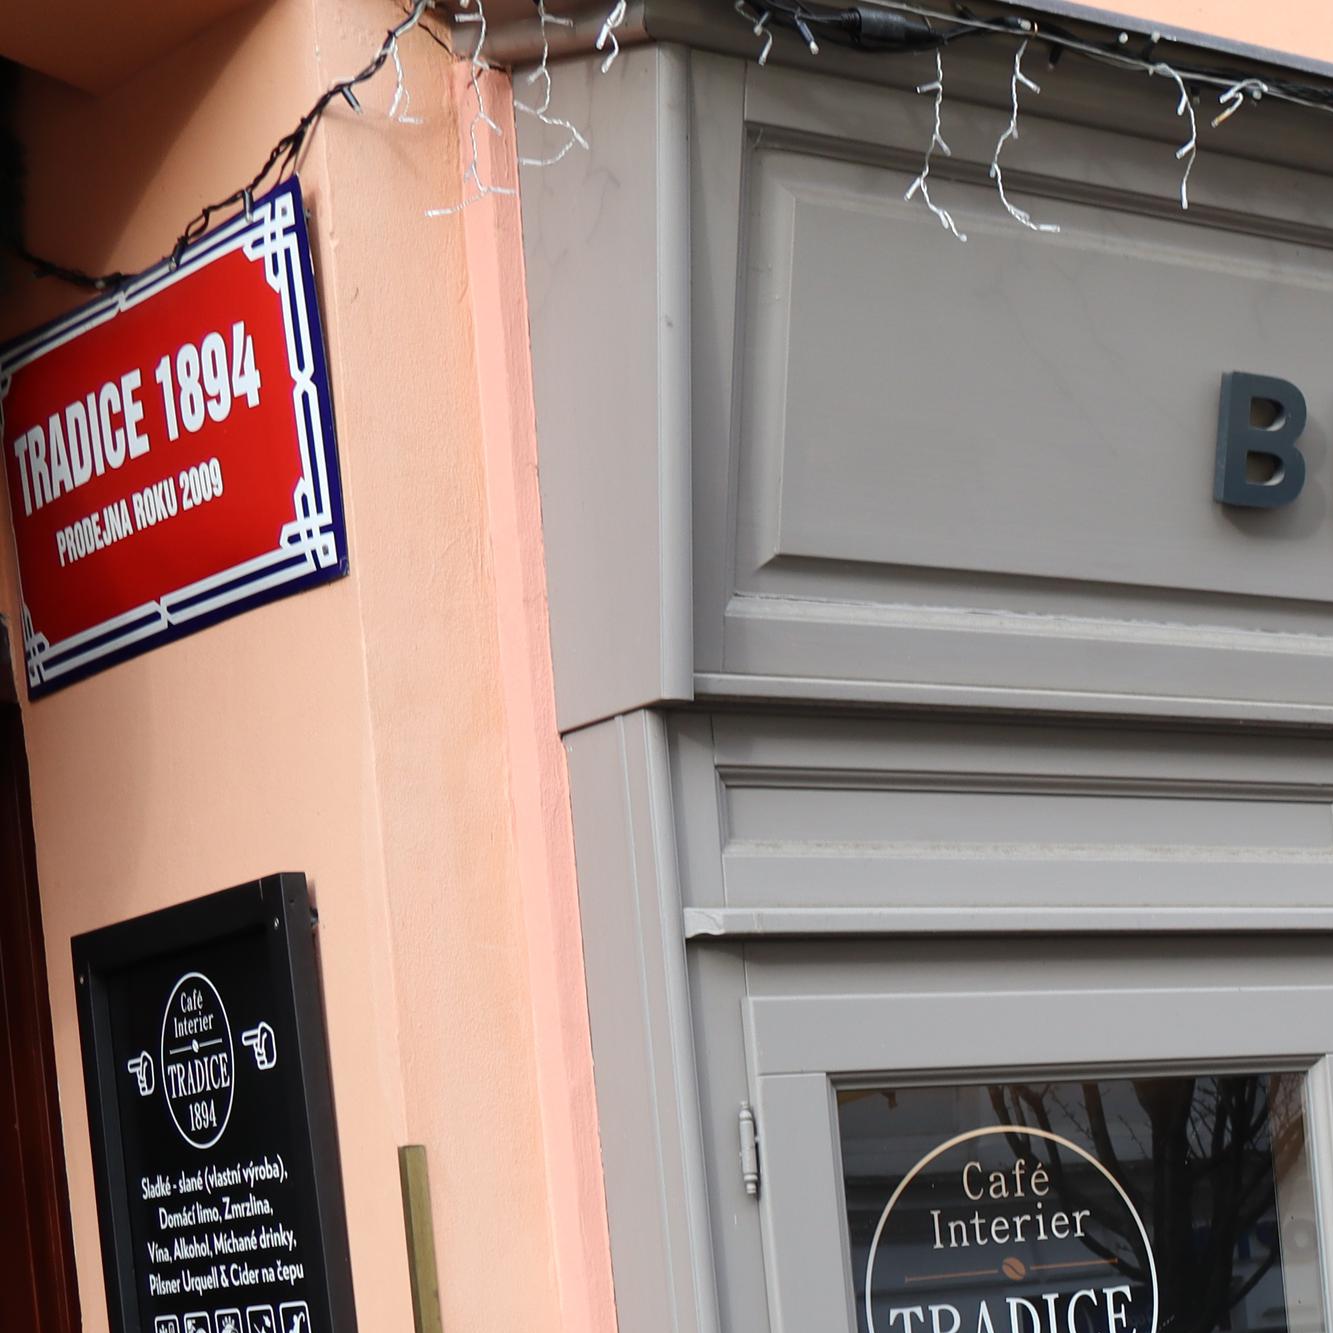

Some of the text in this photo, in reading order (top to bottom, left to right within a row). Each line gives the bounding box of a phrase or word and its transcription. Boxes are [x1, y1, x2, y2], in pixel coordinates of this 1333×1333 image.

[14, 321, 262, 518] TRADICE 1894
[56, 457, 225, 567] PRODEJNA ROKU 2009
[180, 988, 204, 1013] Café
[174, 1011, 214, 1038] Interier
[167, 1052, 231, 1099] TRADICE
[189, 1099, 217, 1131] 1894
[141, 1174, 172, 1200] Sladké
[178, 1170, 203, 1194] slané
[962, 1159, 1050, 1200] Café
[158, 1193, 274, 1230] Domácí limo, Zmrzlina,
[930, 1201, 1091, 1249] Interier
[147, 1223, 297, 1264] Vína, Alkohol, Míchané drinky,
[149, 1259, 304, 1296] Pilsner Urquell & Cider na čepu
